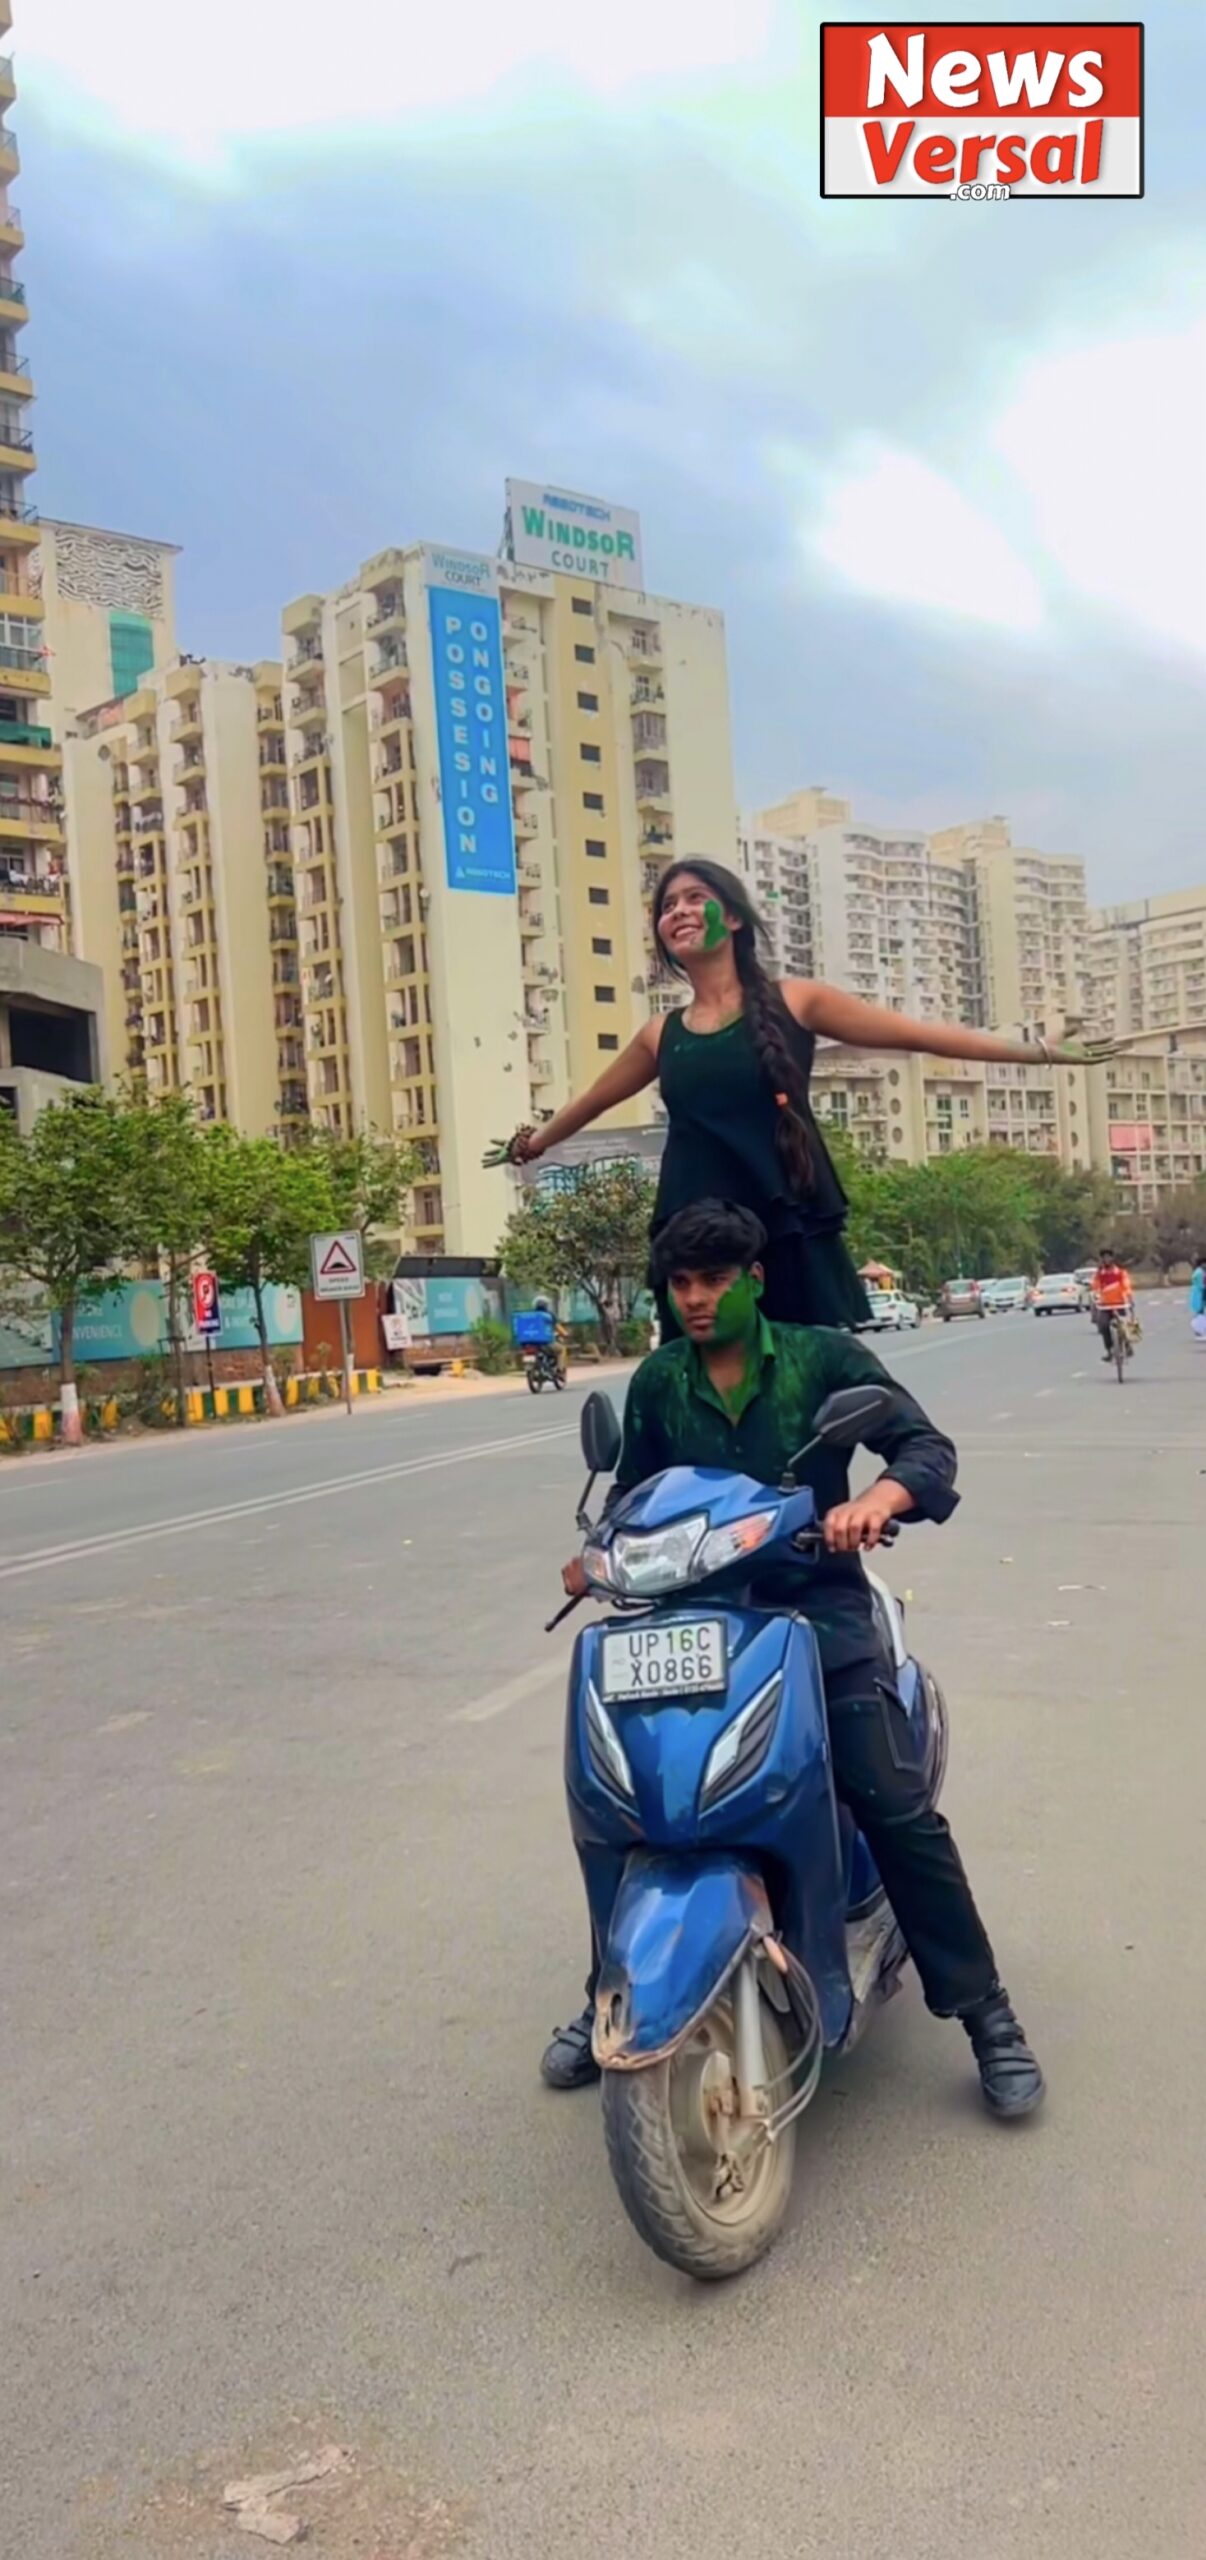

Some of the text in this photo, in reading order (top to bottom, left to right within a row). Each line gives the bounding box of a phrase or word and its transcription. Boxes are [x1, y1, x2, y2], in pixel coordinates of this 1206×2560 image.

[520, 505, 636, 561] WINDSOR
[431, 552, 490, 578] WINDSOR
[444, 569, 481, 587] COURT
[551, 550, 610, 577] COURT
[469, 621, 498, 803] ONGOING
[445, 615, 477, 853] POSSESION
[630, 1655, 713, 1687] X0866
